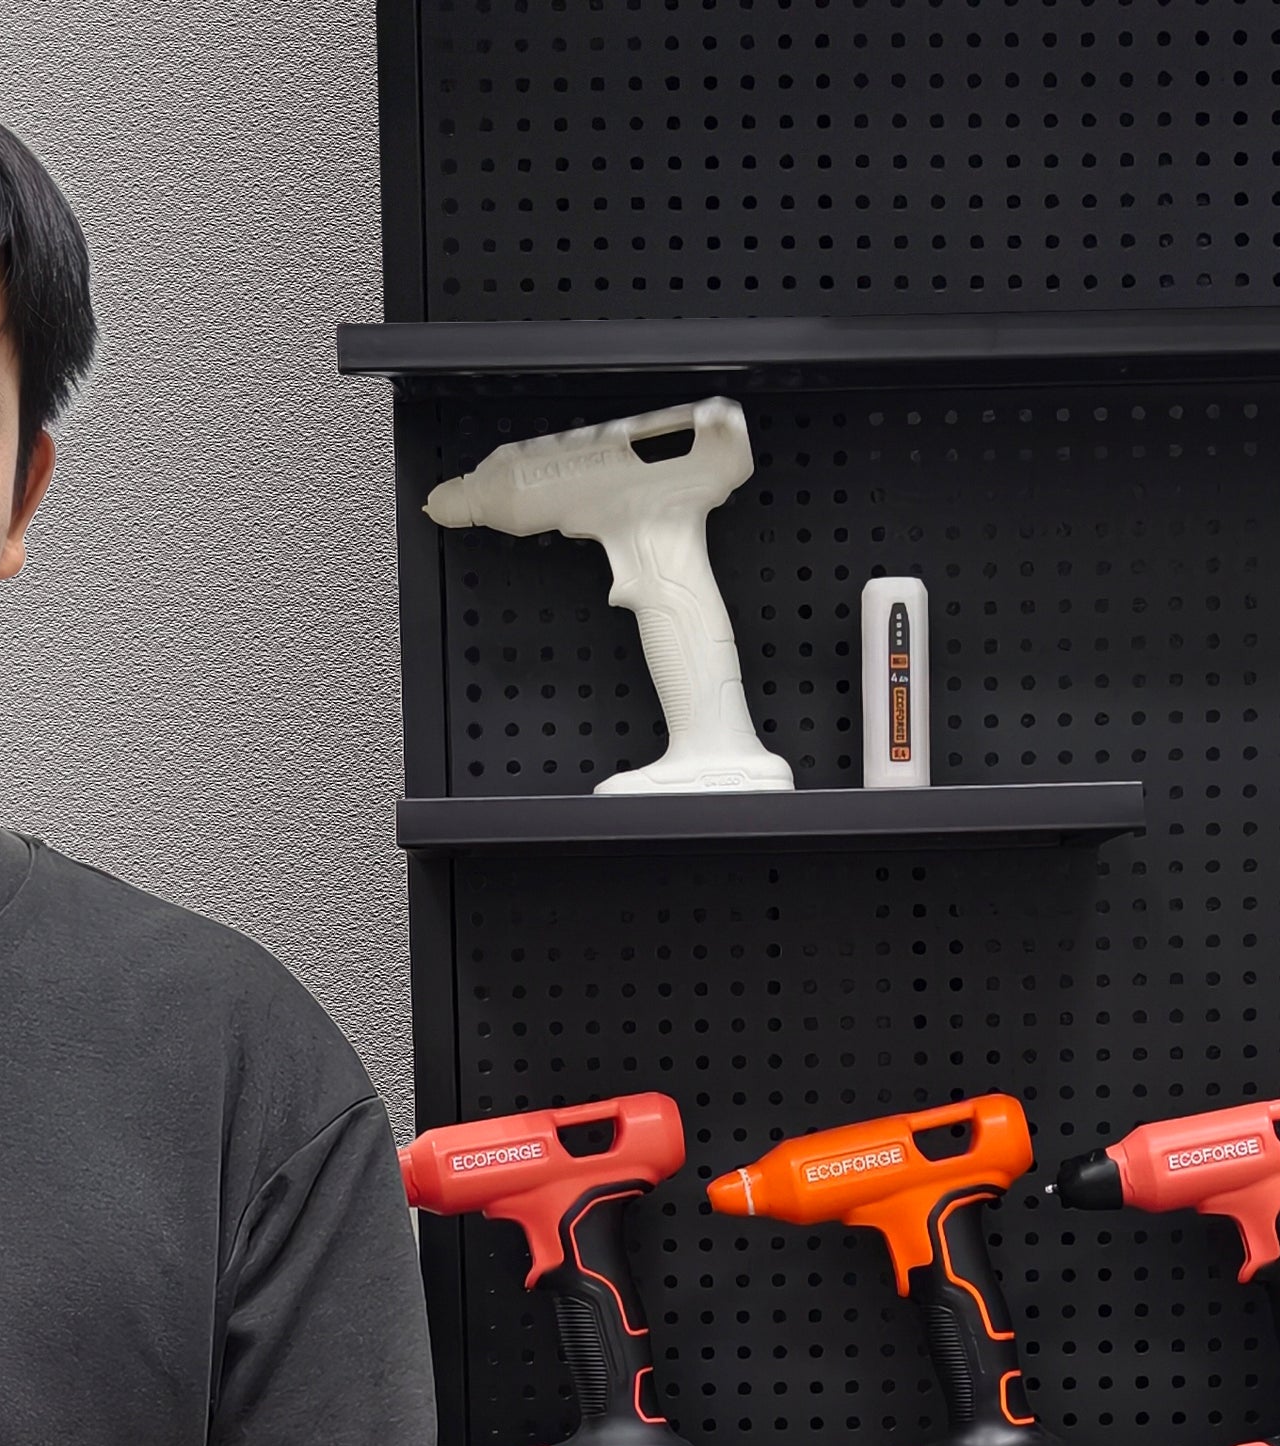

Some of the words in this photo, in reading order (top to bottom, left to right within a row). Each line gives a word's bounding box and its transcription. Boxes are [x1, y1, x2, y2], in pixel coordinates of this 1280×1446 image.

[891, 672, 897, 682] 4
[452, 1143, 542, 1171] ECOFORGE
[805, 1147, 903, 1182] ECOFORGE
[1168, 1139, 1260, 1170] ECOFORGE
